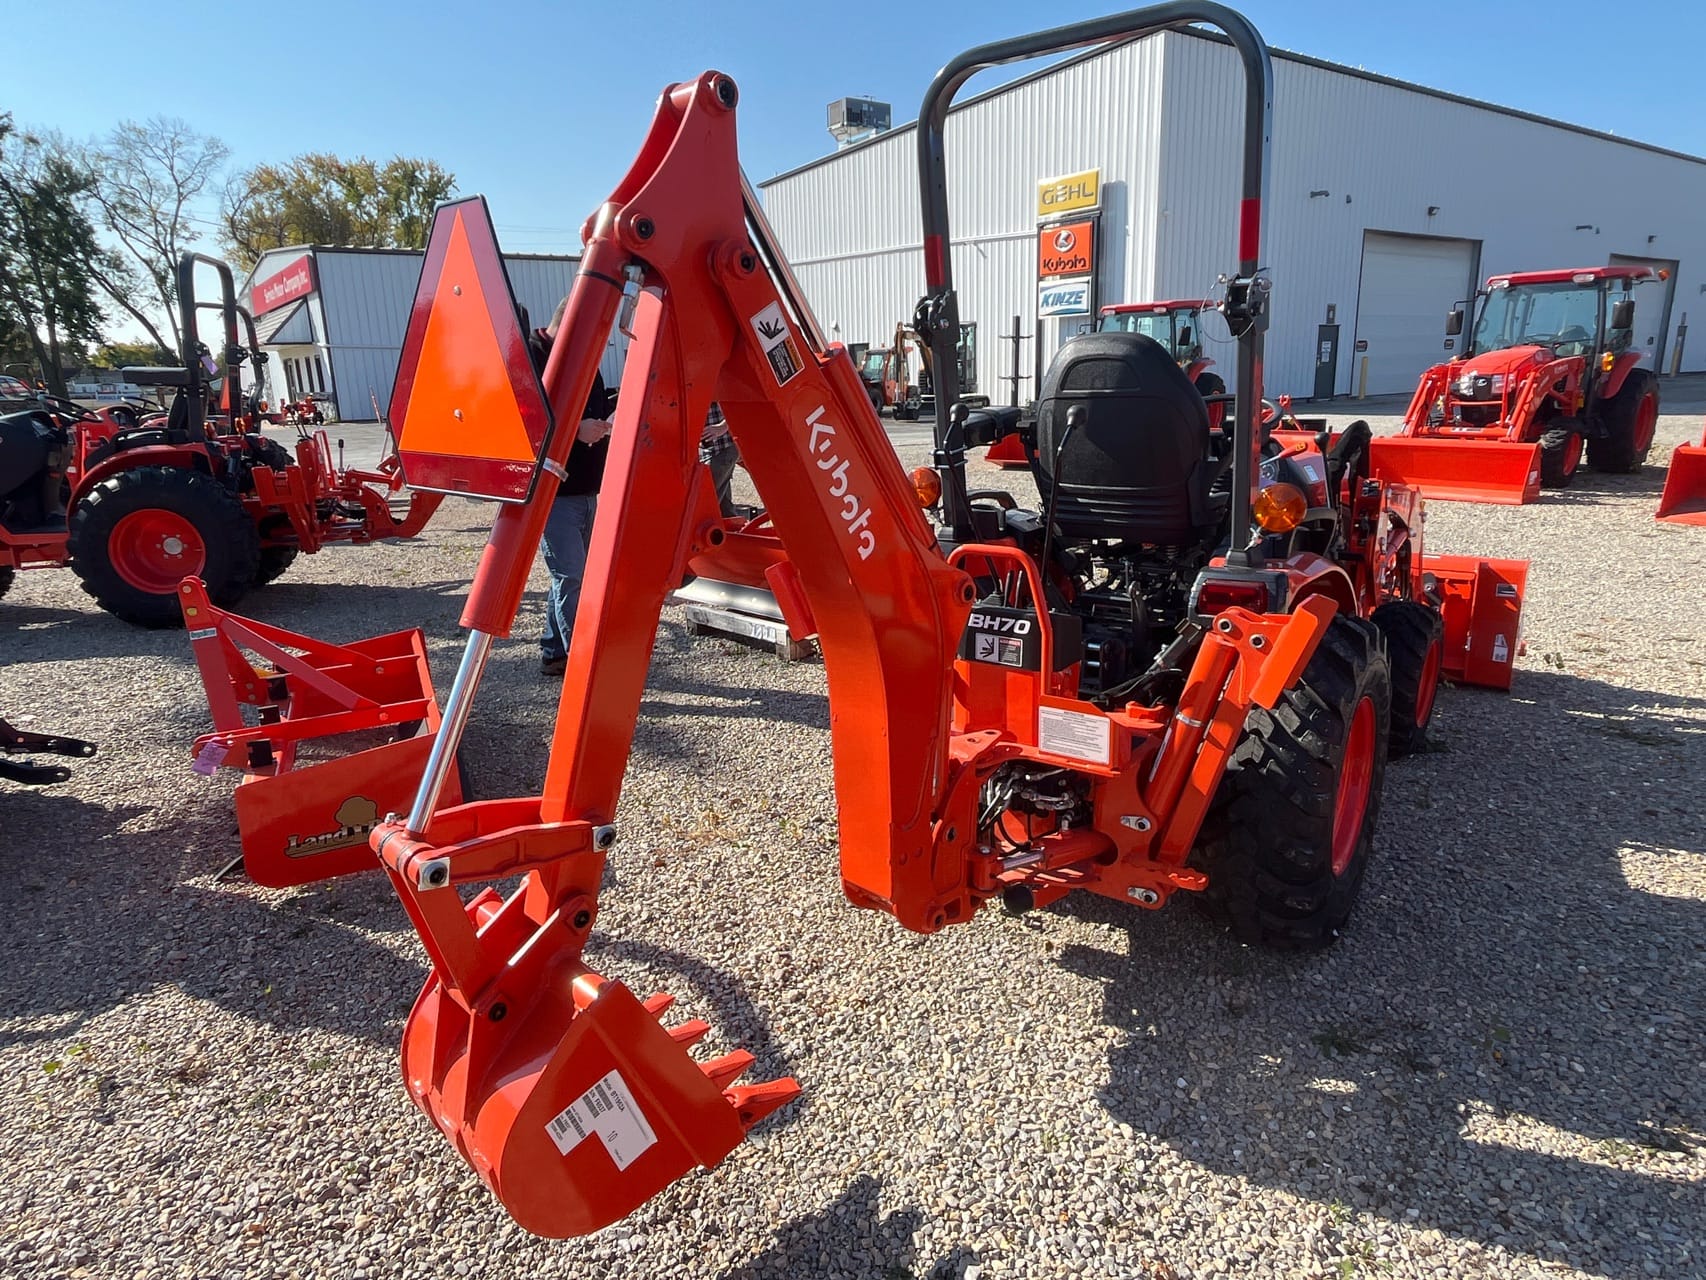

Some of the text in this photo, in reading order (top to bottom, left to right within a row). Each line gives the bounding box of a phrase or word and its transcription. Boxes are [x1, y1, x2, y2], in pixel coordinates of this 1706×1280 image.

[1042, 181, 1094, 206] GEHL
[1042, 254, 1087, 272] Kubota
[1040, 289, 1086, 308] KINZE
[805, 404, 876, 561] Kubota
[967, 613, 1031, 635] BH70
